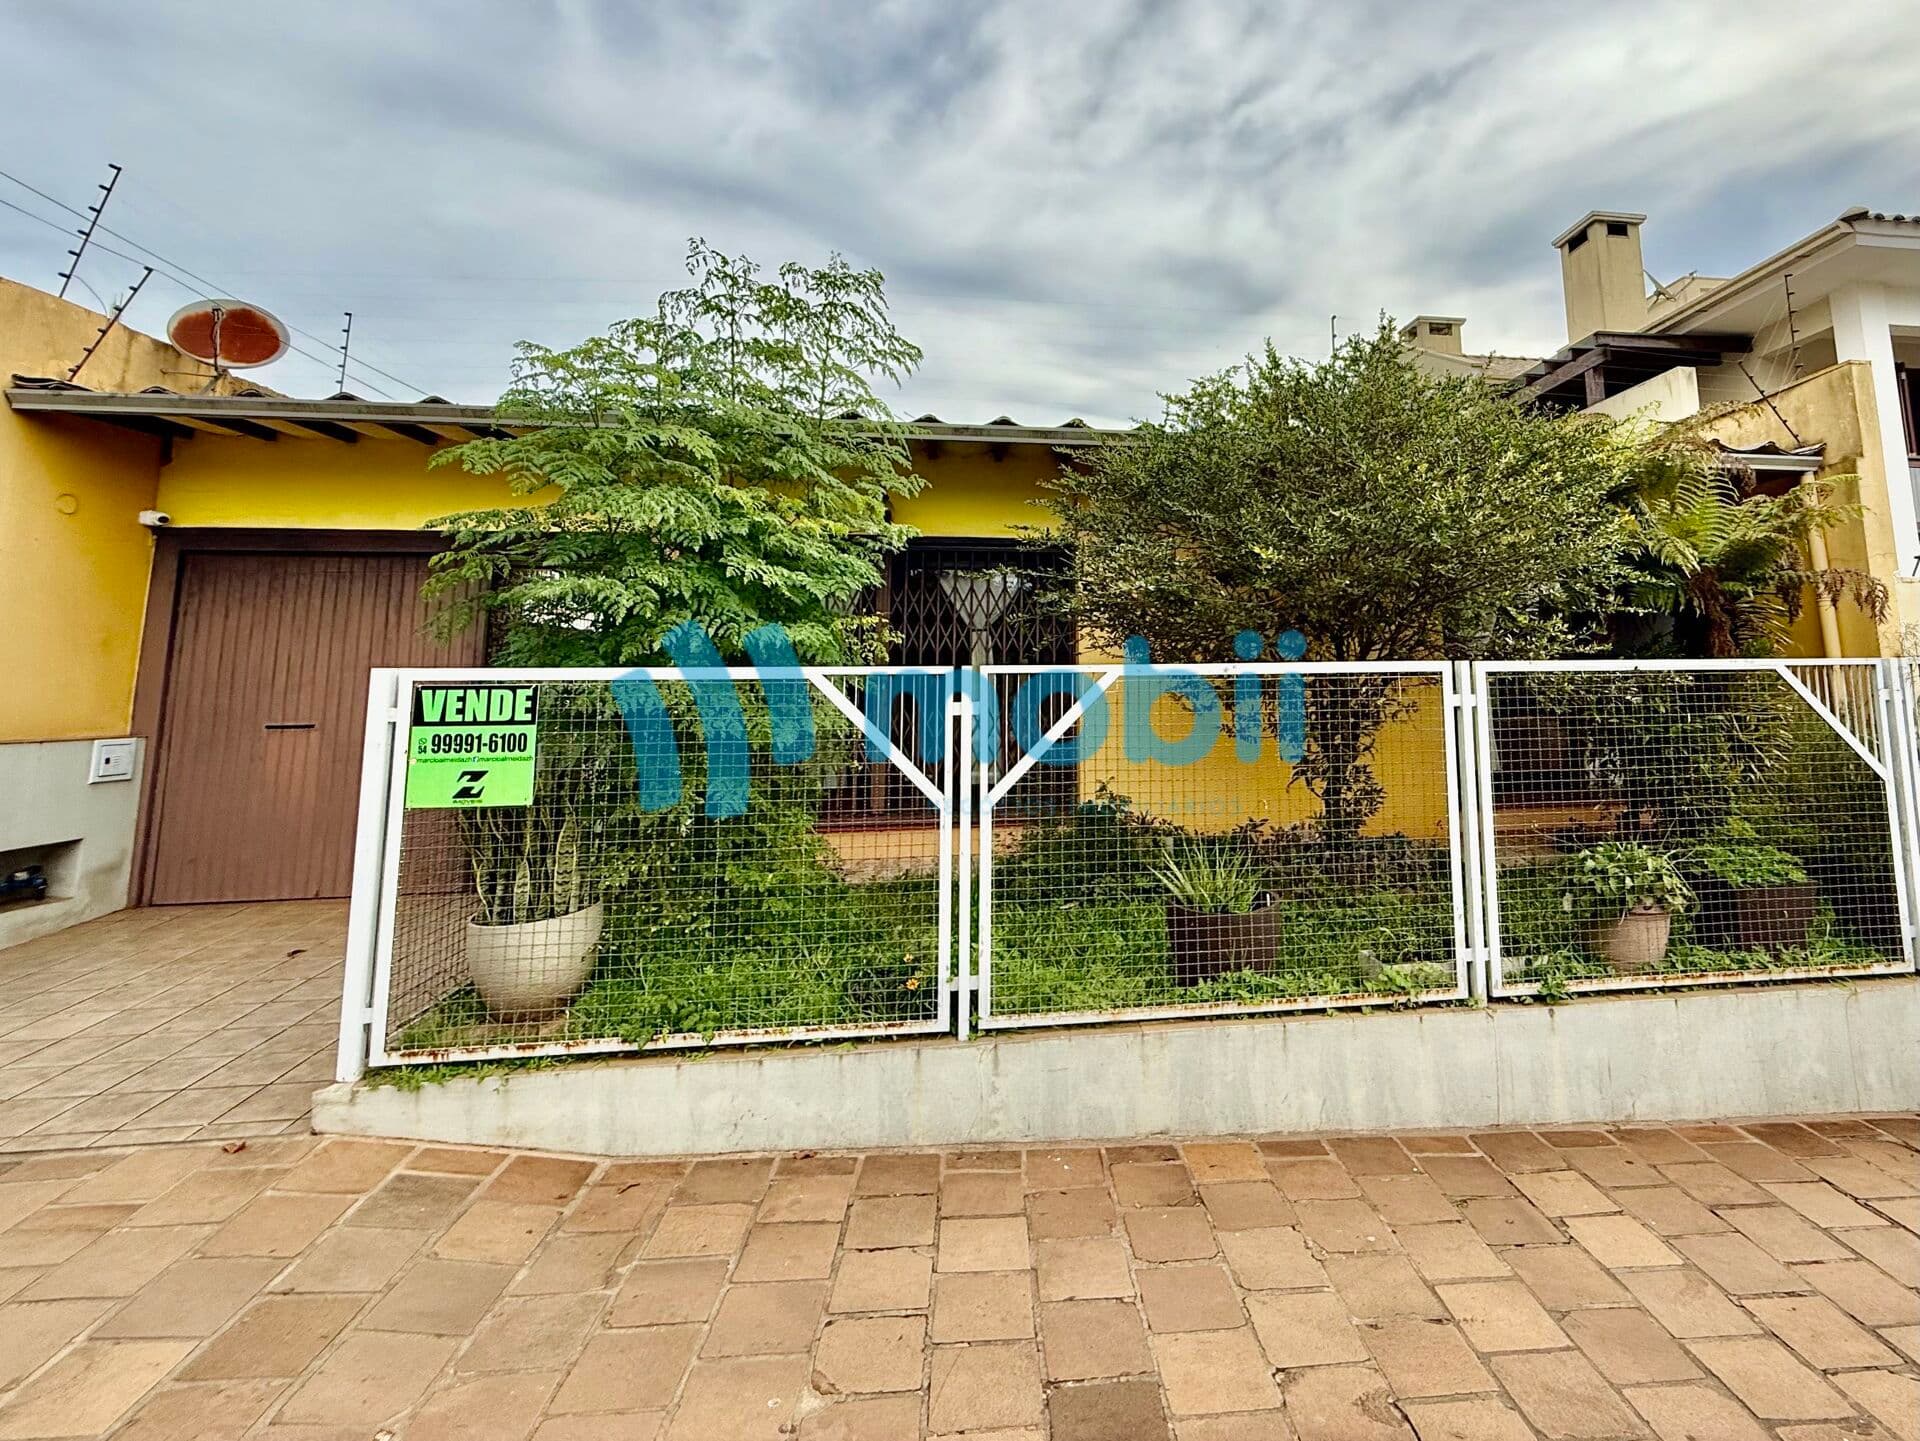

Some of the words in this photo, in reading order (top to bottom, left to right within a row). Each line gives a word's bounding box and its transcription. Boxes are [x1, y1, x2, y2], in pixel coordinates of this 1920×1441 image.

[421, 688, 534, 722] VENDE
[418, 745, 427, 754] 54
[431, 732, 528, 754] 99991-6100
